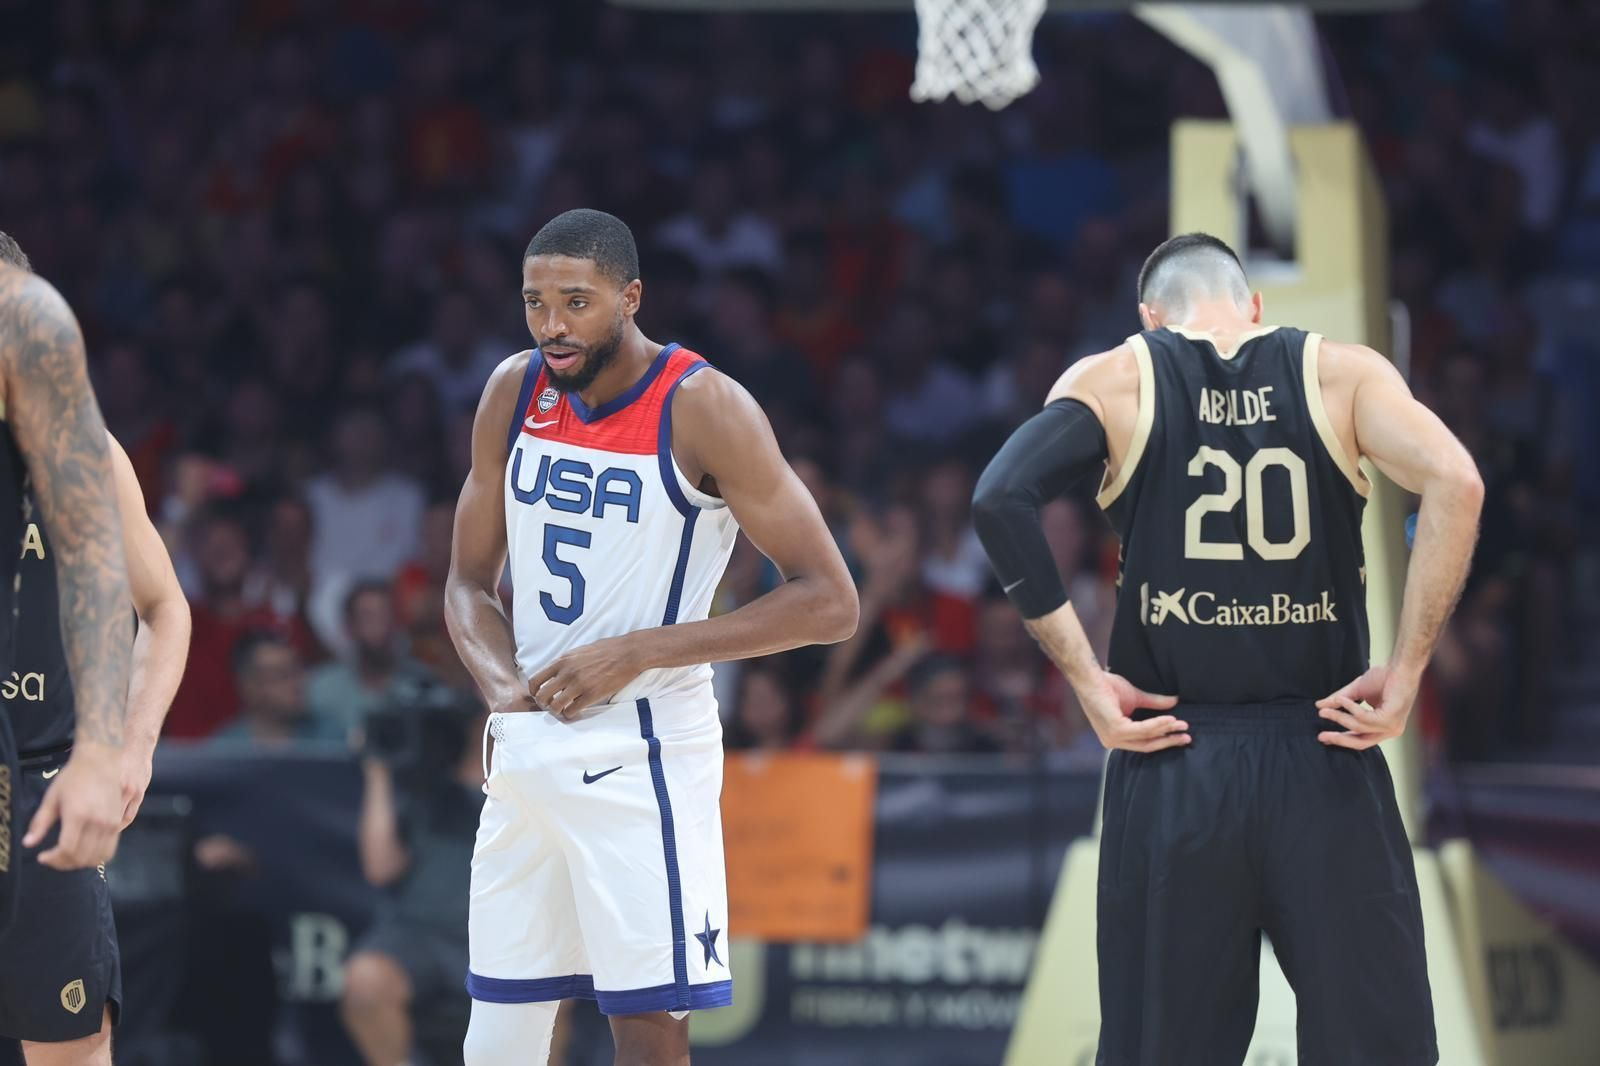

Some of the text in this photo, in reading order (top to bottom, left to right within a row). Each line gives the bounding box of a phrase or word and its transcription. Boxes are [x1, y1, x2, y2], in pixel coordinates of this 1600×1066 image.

[511, 448, 643, 523] USA
[1185, 445, 1312, 561] 20
[540, 523, 592, 626] 5
[1188, 590, 1338, 626] CaixaBank
